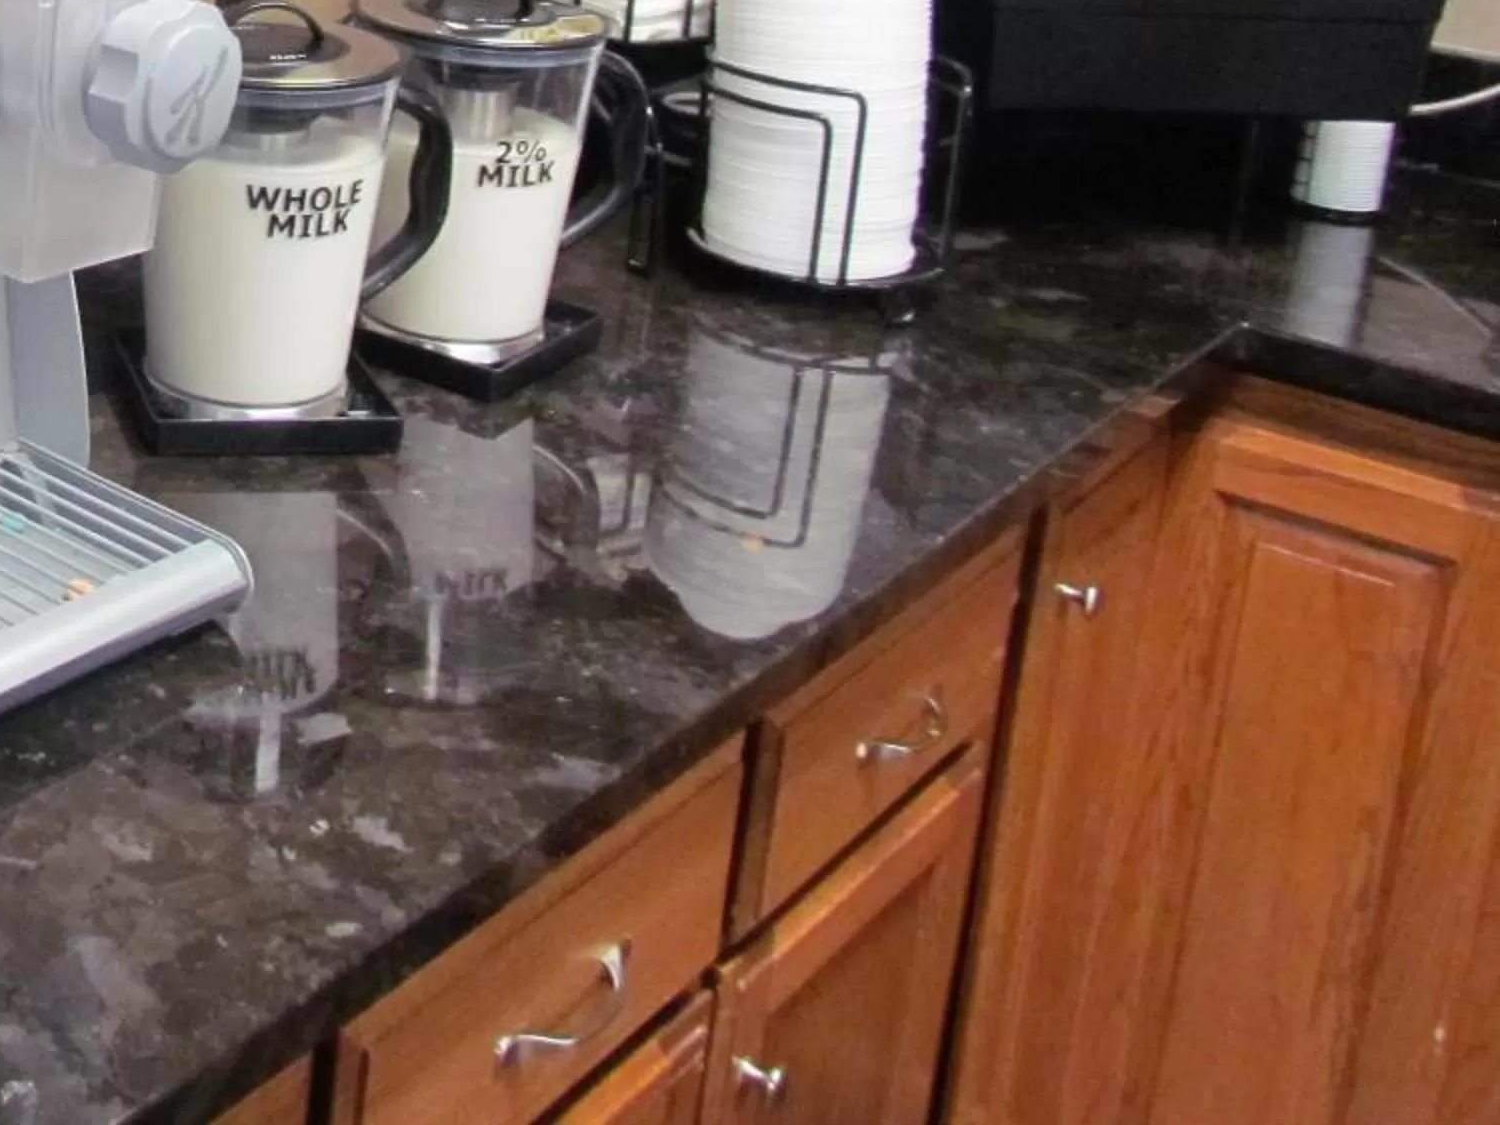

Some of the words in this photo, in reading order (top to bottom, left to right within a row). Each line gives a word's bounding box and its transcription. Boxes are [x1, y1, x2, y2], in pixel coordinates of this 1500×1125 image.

[495, 140, 548, 164] 2%
[477, 161, 555, 189] MILK
[246, 179, 364, 213] WHOLE
[266, 208, 351, 239] MILK
